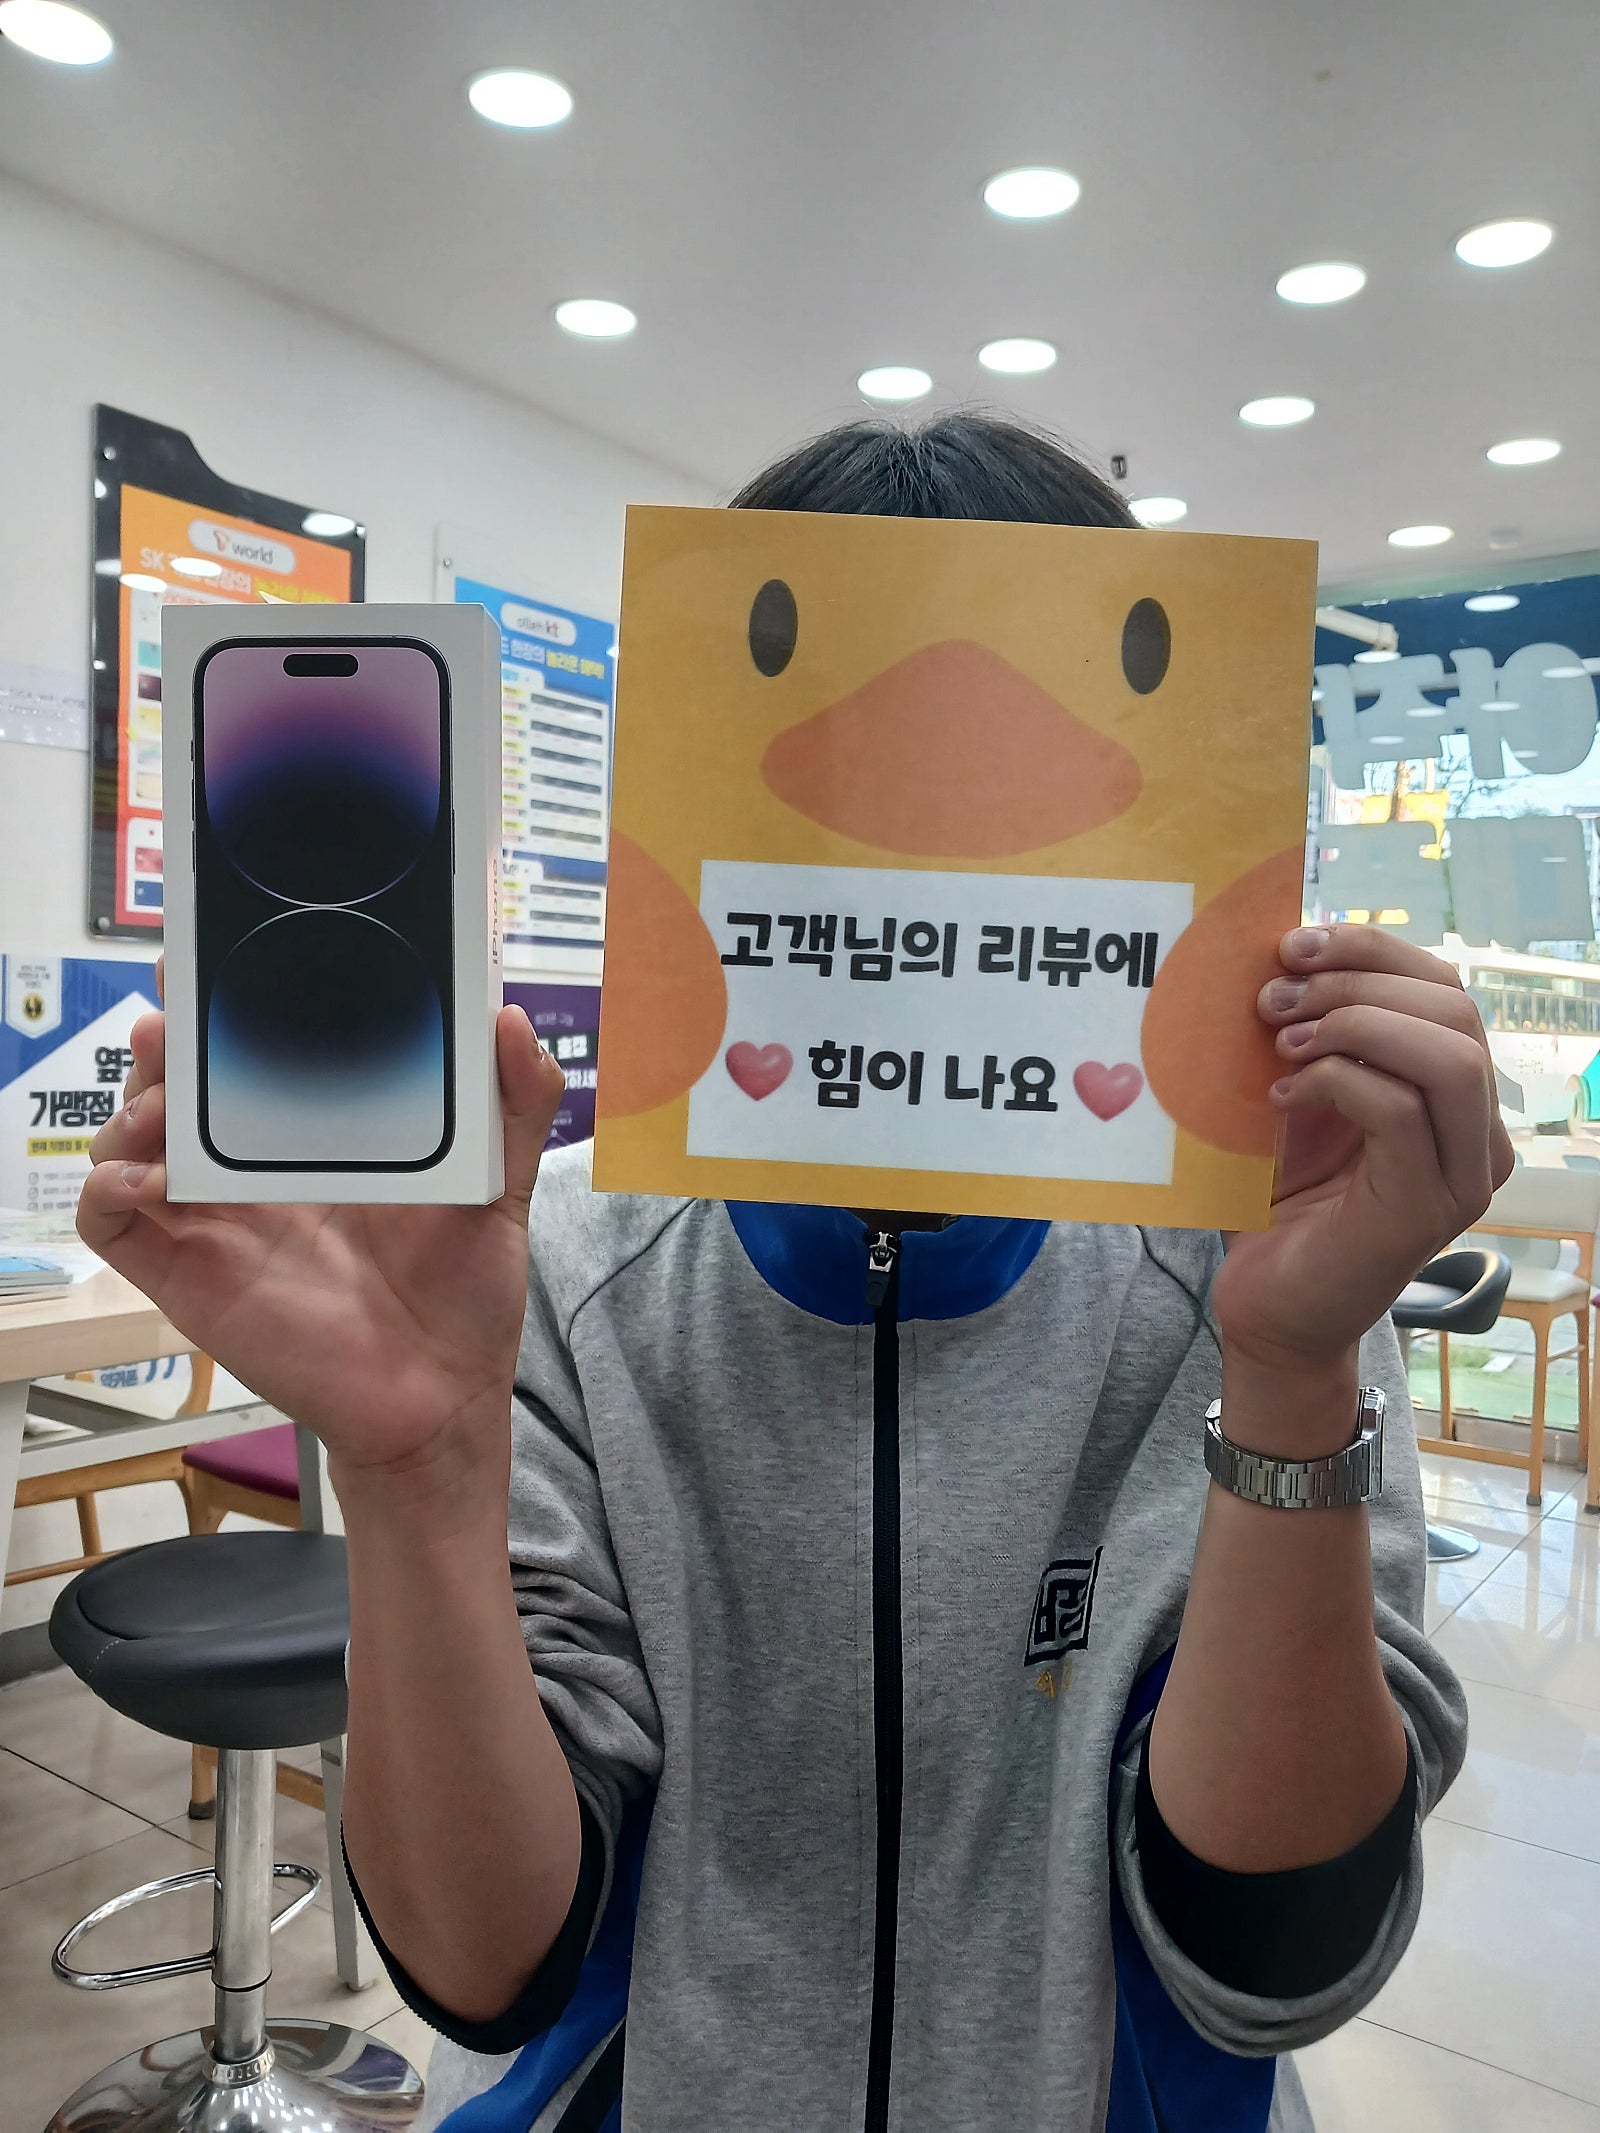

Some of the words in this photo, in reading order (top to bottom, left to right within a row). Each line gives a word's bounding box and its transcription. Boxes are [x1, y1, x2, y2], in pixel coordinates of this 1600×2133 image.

[140, 547, 165, 571] SK
[232, 542, 274, 566] world
[721, 911, 959, 982] 고객님의
[978, 925, 1159, 988] 리뷰에
[808, 1039, 925, 1109] 힘이
[944, 1054, 1059, 1112] 나요
[29, 1090, 116, 1128] 가맹점
